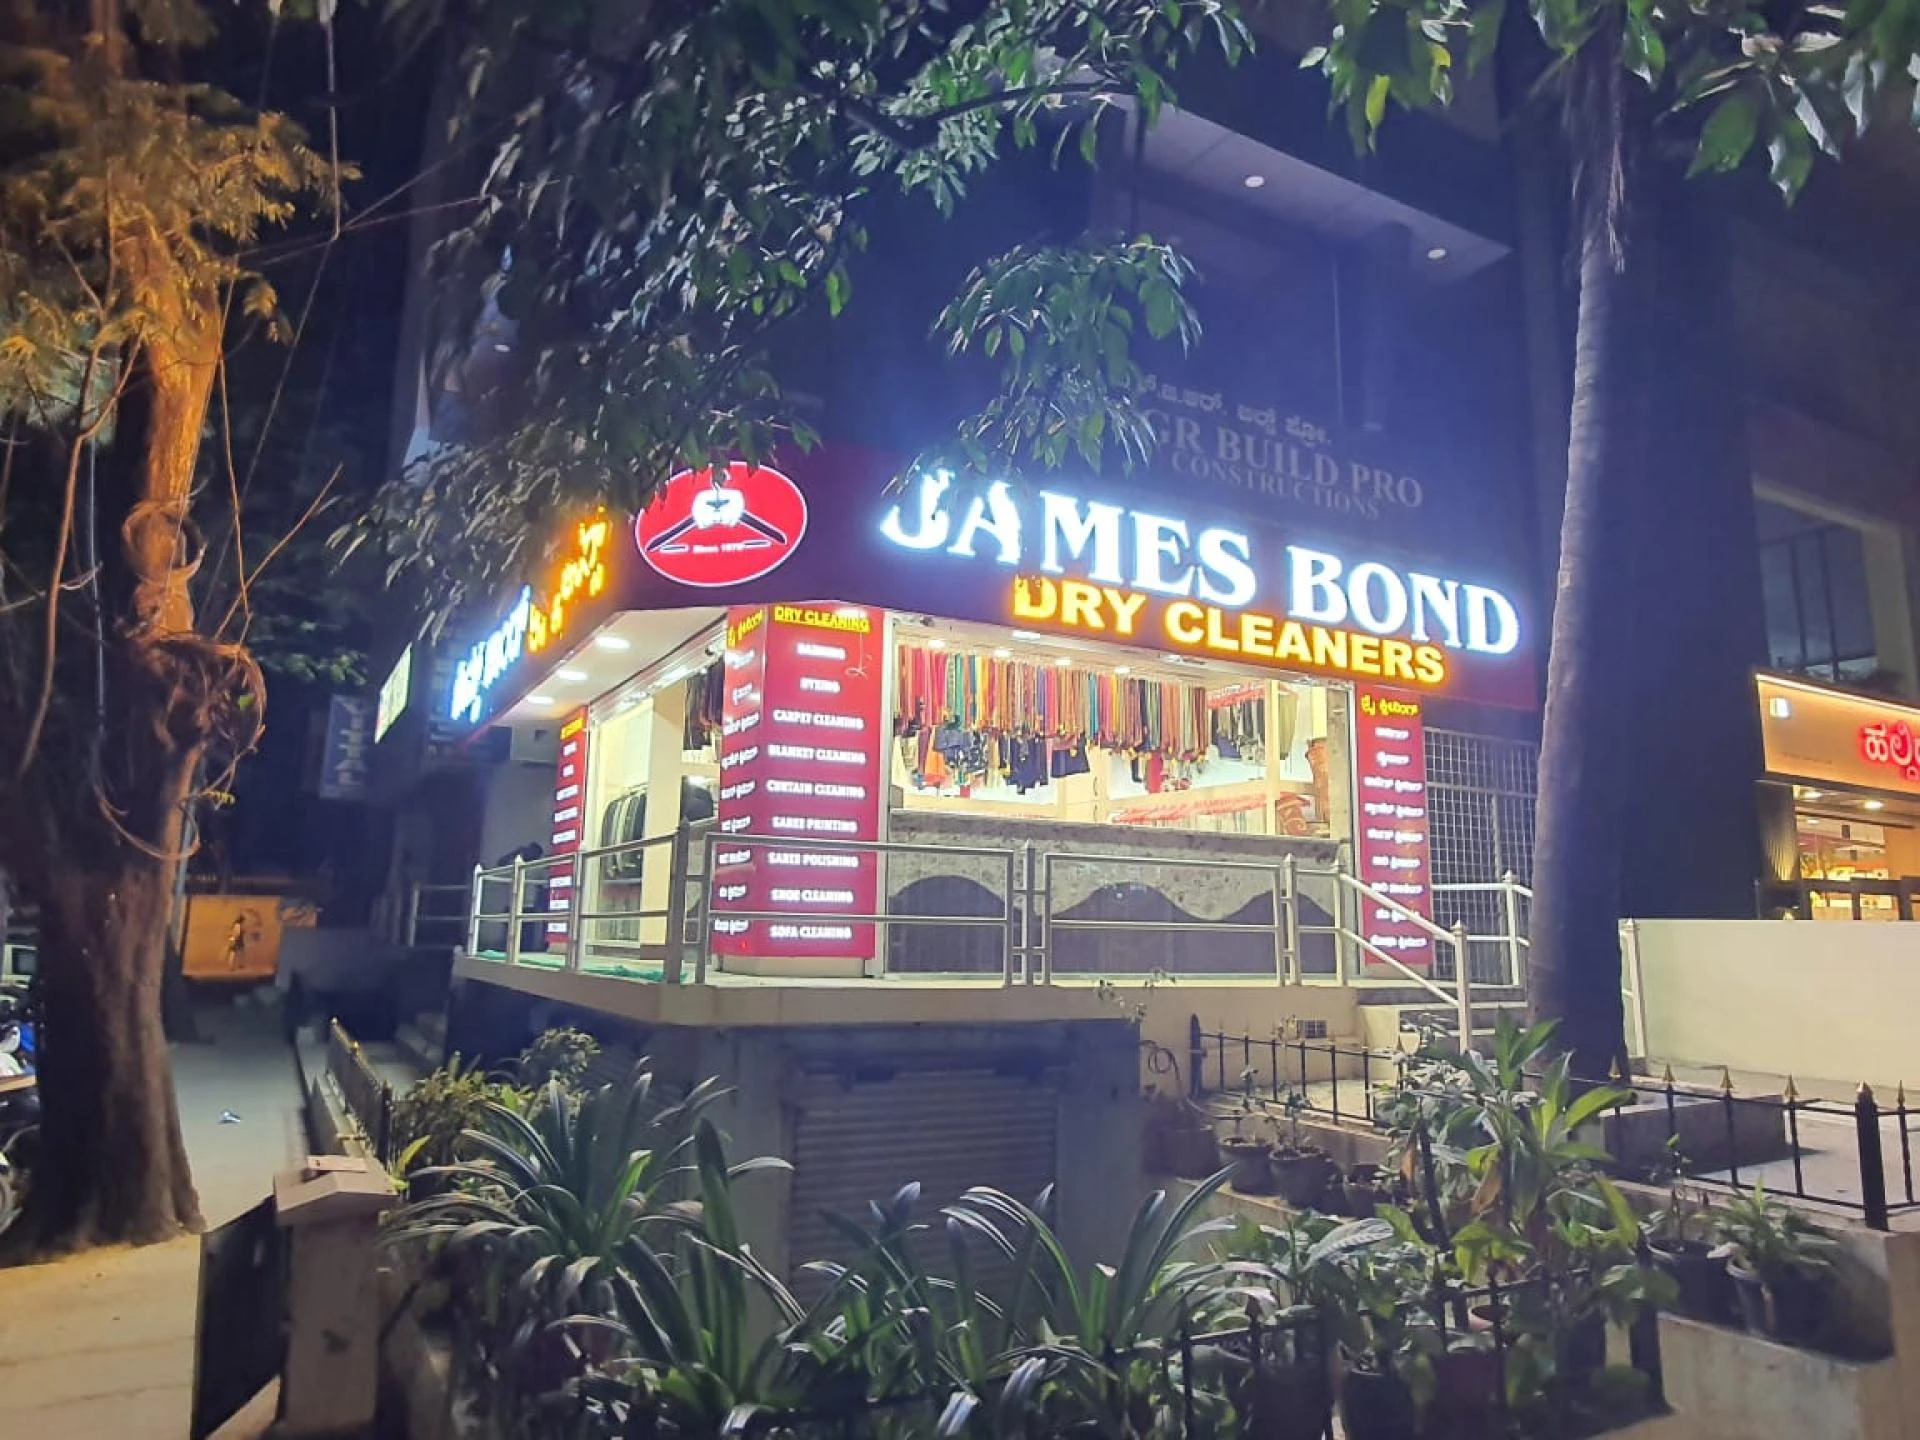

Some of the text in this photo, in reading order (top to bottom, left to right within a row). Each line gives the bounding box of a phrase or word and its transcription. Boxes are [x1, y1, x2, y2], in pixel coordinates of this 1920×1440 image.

[1216, 426, 1341, 488] BUILD
[1351, 462, 1424, 508] PRO
[1171, 450, 1380, 521] CONSTRUCTIONS
[880, 469, 1521, 655] JAMES BOND
[774, 606, 871, 633] DRY CLEANING
[1013, 575, 1445, 685] DRY CLEANERS
[813, 713, 864, 729] CLEANING
[816, 749, 866, 764] CLEANING
[815, 784, 866, 798] CLEANING
[801, 889, 854, 903] CLEANING
[769, 925, 853, 939] SOFA CLEANING
